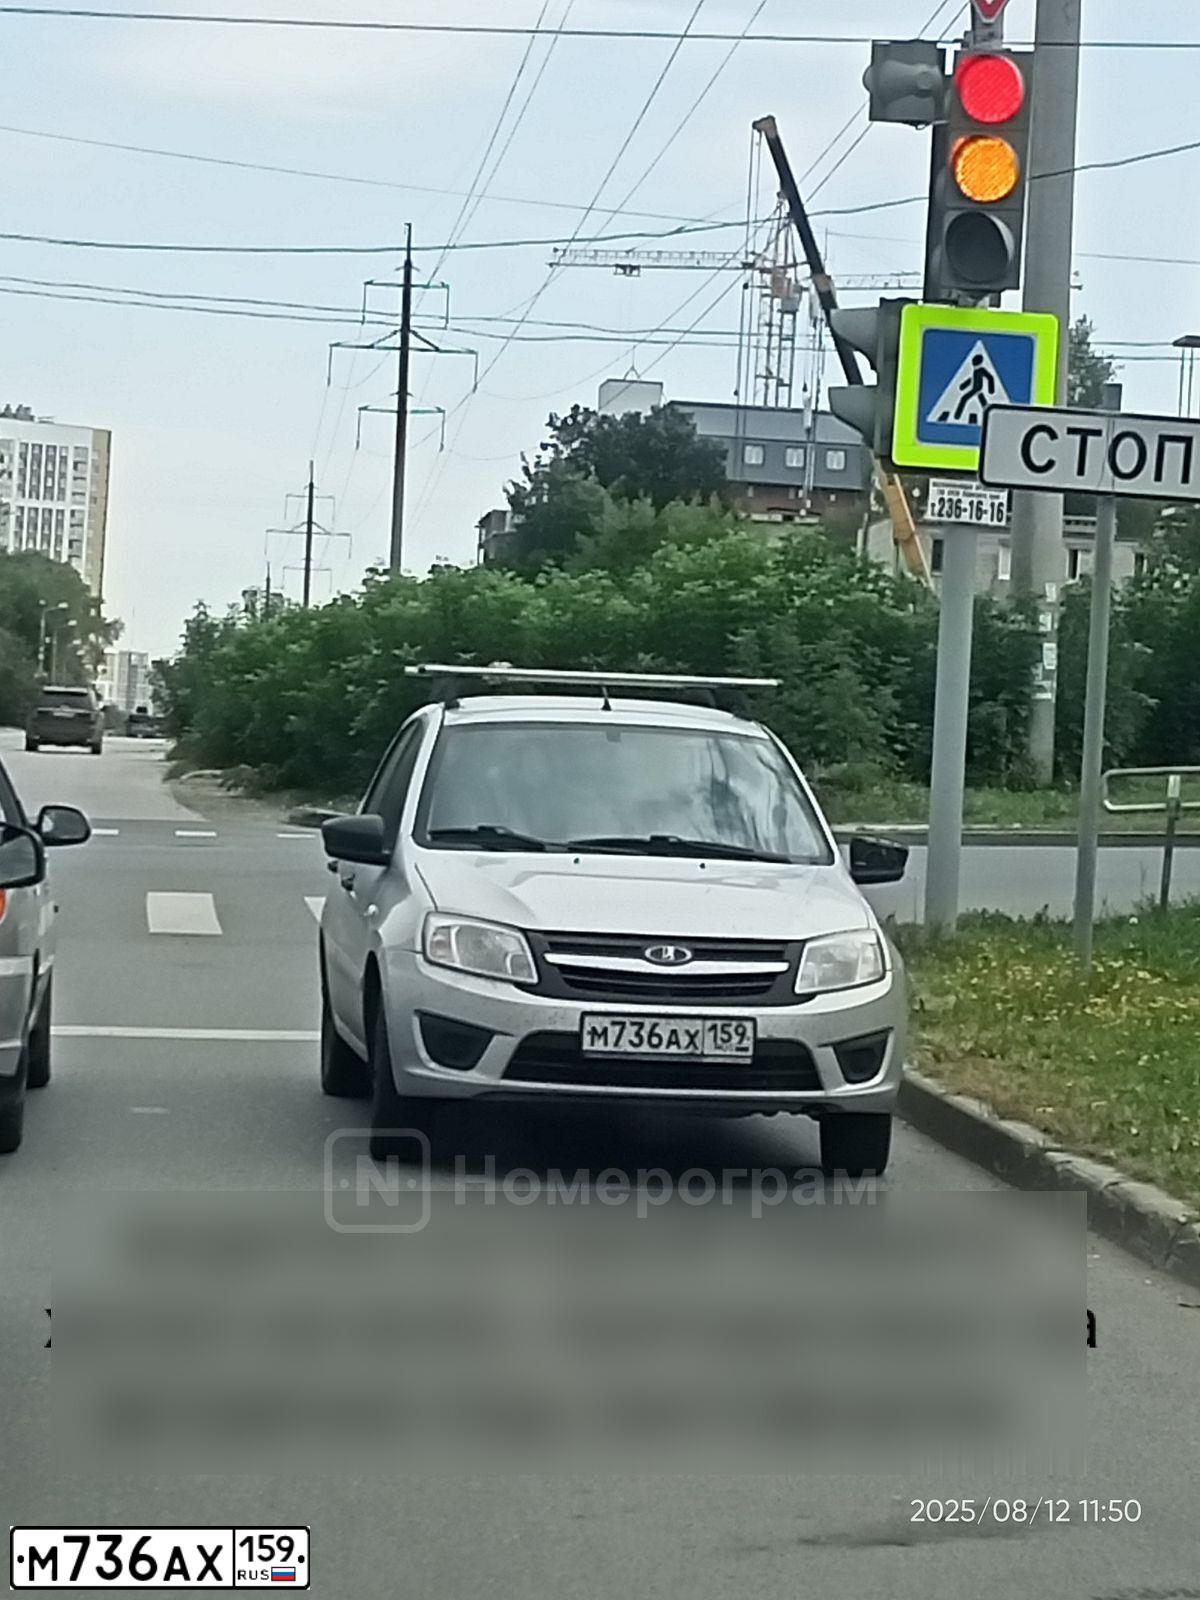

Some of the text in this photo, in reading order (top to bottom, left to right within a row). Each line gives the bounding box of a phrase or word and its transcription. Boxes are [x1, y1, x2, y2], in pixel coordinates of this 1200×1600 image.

[1021, 424, 1193, 484] СТОП
[589, 1021, 747, 1050] М736АХ 159
